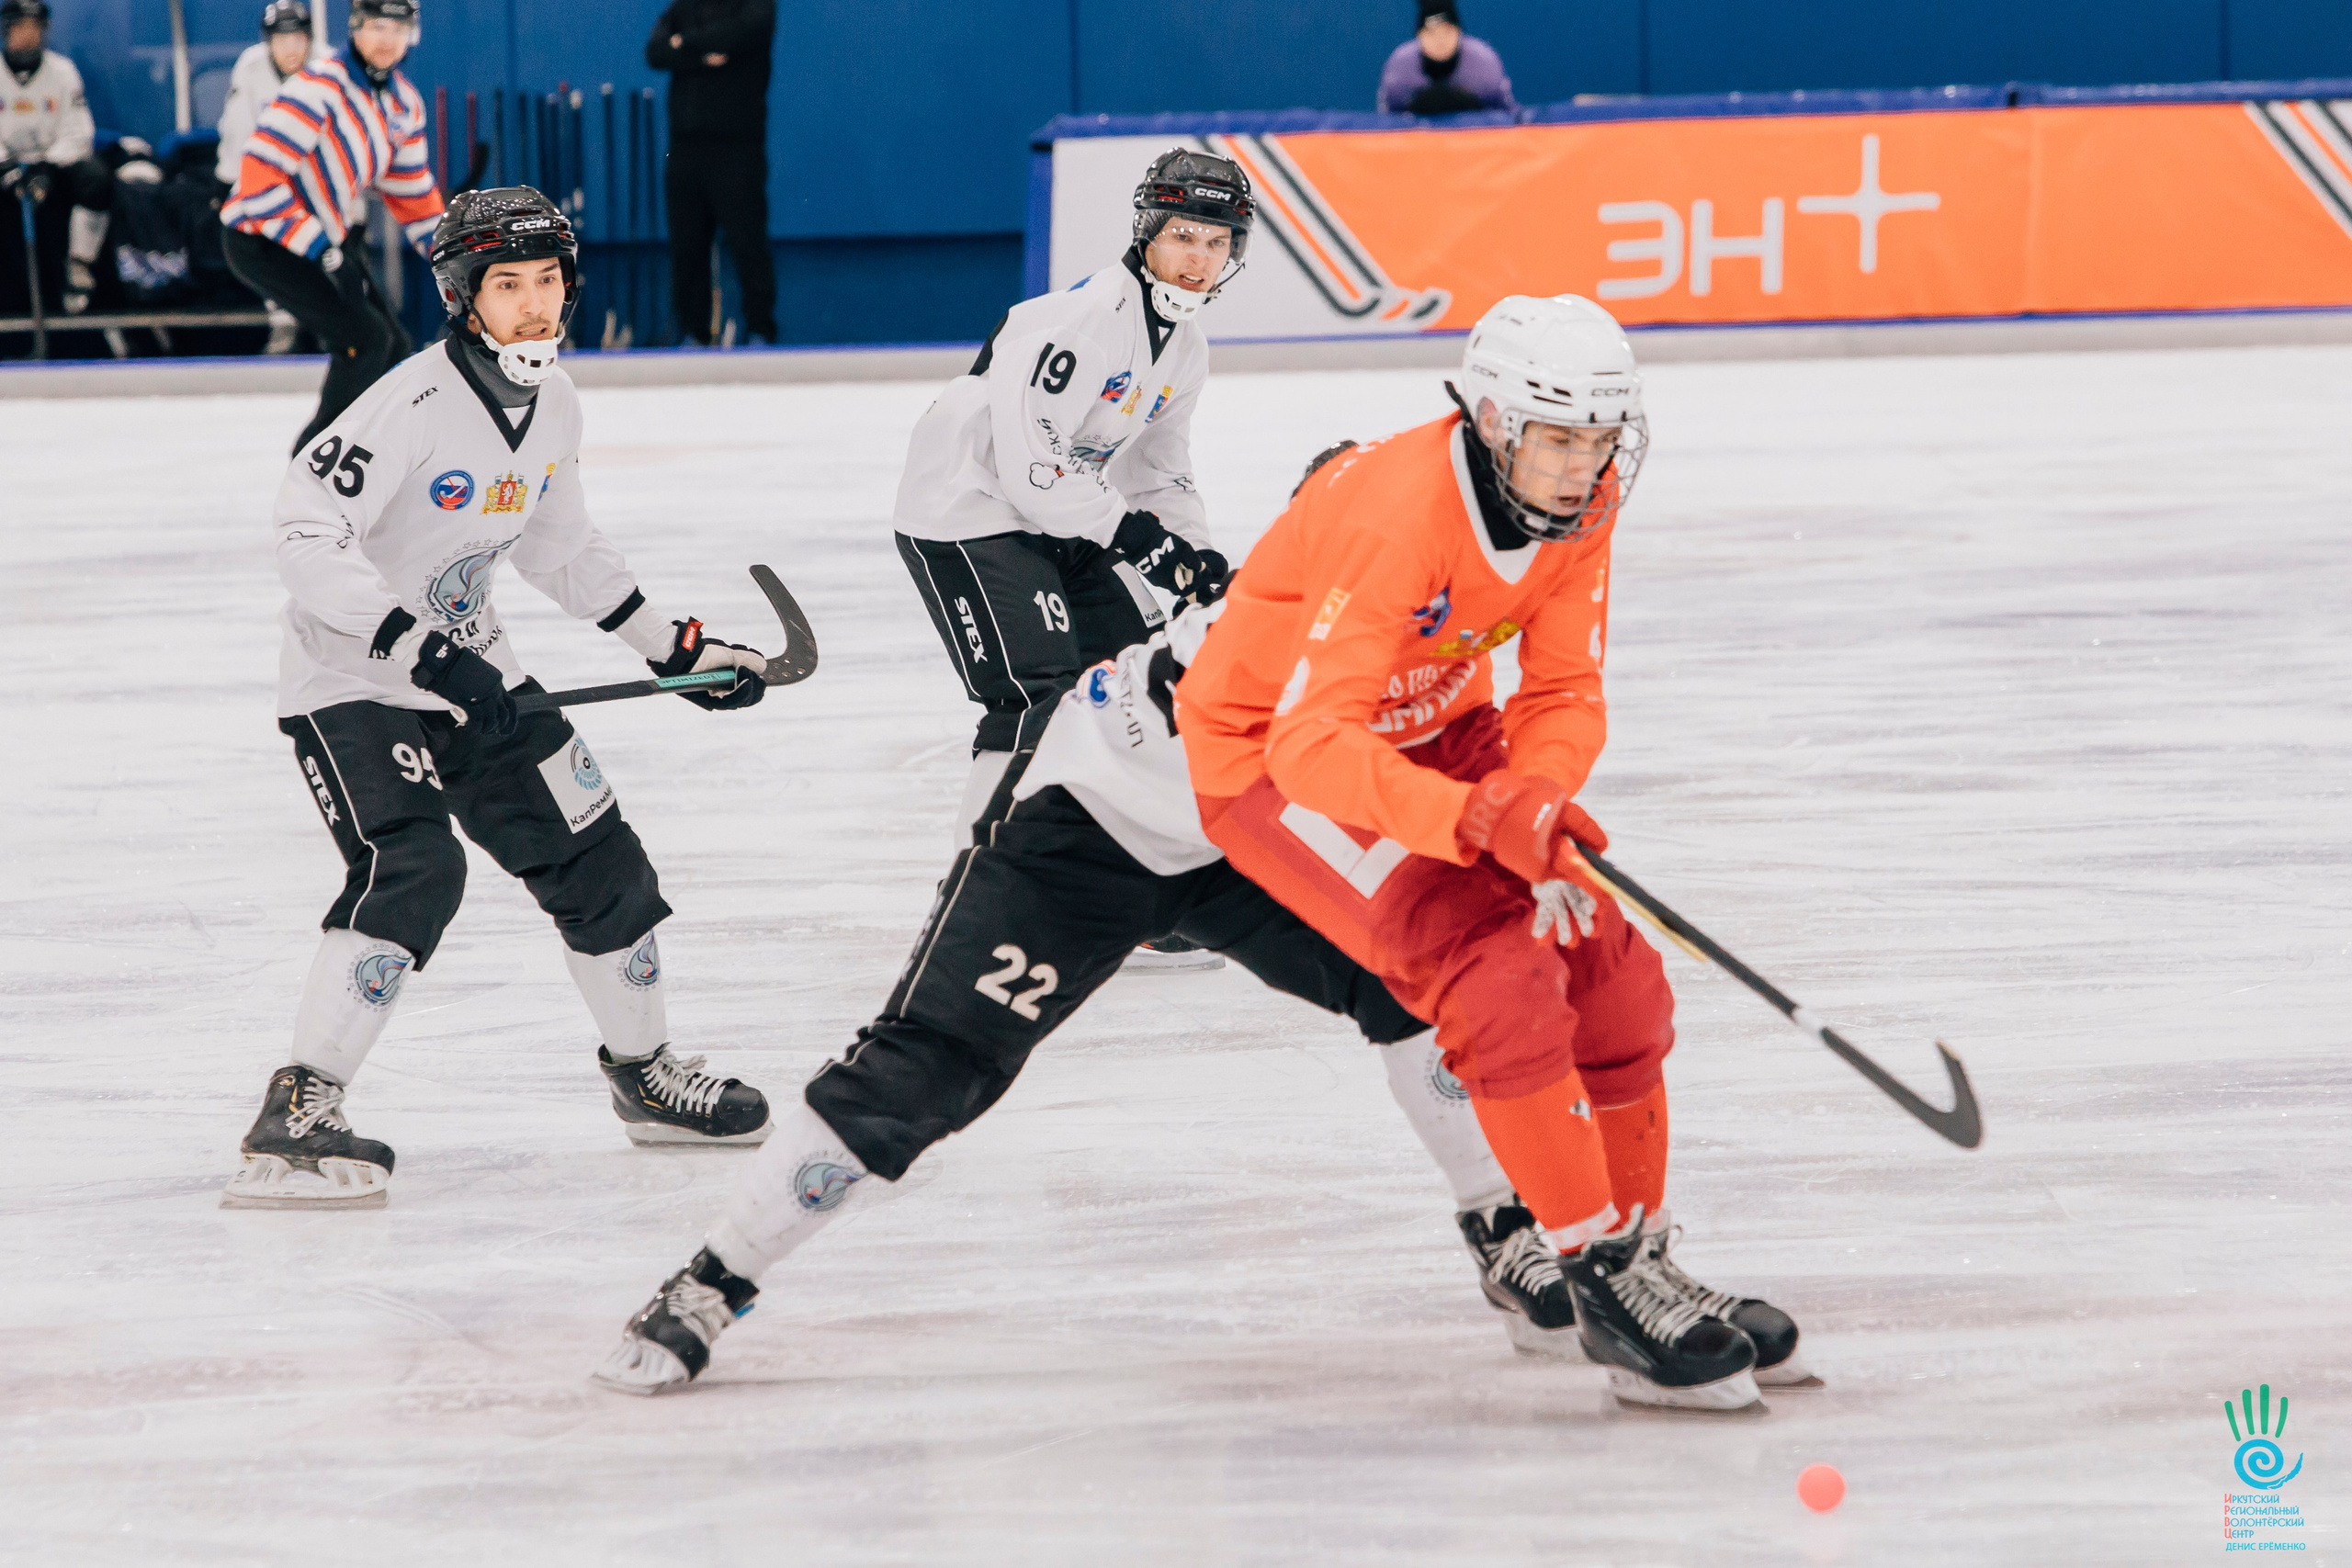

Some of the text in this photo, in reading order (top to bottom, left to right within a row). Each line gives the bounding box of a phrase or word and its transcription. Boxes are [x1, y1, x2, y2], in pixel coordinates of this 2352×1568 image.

[1194, 187, 1231, 201] CCM
[512, 220, 550, 231] CCM
[1030, 342, 1077, 394] 19
[412, 386, 438, 408] STEX
[1591, 388, 1629, 397] CCM
[307, 435, 374, 498] 95
[1135, 536, 1175, 574] CM
[955, 596, 988, 663] STEX
[1034, 591, 1069, 632] 19
[684, 626, 695, 648] CCM
[303, 756, 341, 826] STEX
[974, 943, 1059, 1021] 22
